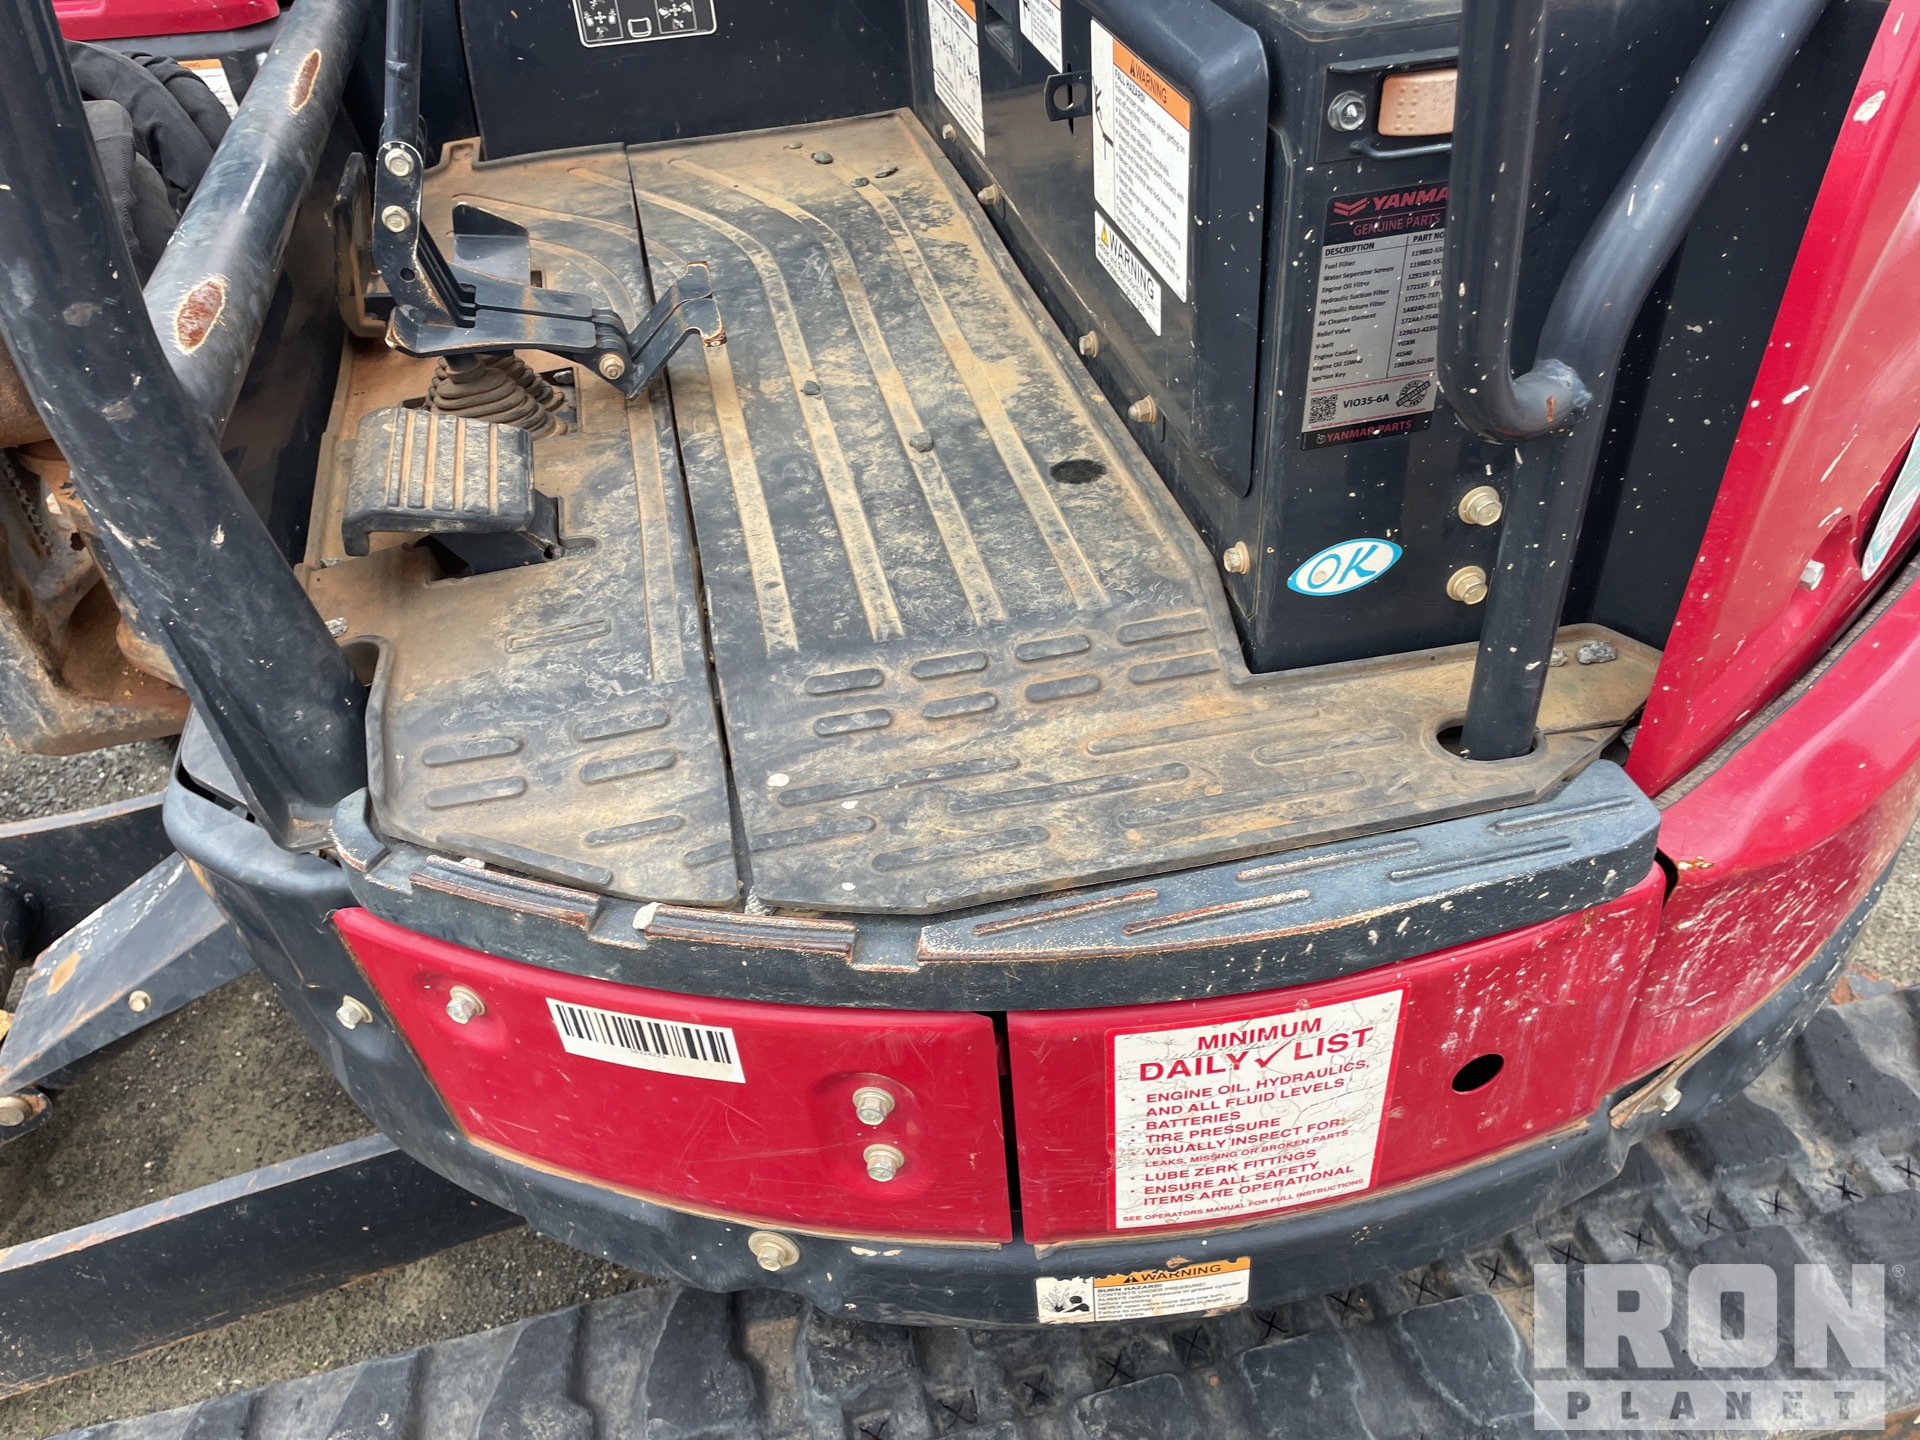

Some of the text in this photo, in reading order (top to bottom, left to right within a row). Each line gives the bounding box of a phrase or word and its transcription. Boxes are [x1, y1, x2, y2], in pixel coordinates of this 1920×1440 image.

[1135, 63, 1167, 104] WARNING
[1372, 186, 1448, 211] YANMA
[1353, 213, 1441, 236] GENUINE PARTS
[1412, 233, 1432, 243] PART
[1325, 242, 1375, 257] DESCRIPTION
[1411, 247, 1444, 257] 119802-55
[1109, 230, 1155, 300] WARNING
[1373, 266, 1394, 274] Screen
[1321, 289, 1390, 305] Hydraulic Suction Filter
[1322, 285, 1342, 293] Engine
[1319, 306, 1347, 316] Hydraulic
[1348, 303, 1368, 311] Return
[1327, 317, 1350, 325] Cleaner
[1351, 313, 1376, 321] Element
[1317, 330, 1334, 338] Relief
[1314, 349, 1358, 361] Engine Coolant
[1334, 371, 1346, 379] Key
[1327, 420, 1412, 442] YANMAR PARTS
[1307, 544, 1378, 589] OK
[1198, 1017, 1322, 1050] MINIMUM
[1140, 1027, 1374, 1081] DAILY LIST
[1146, 1059, 1370, 1103] ENGINE OIL, HYDRAULICS,
[1146, 1078, 1345, 1117] AND ALL FLUID LEVELS
[1145, 1117, 1281, 1143] TIRE PRESSURE
[1146, 1111, 1241, 1130] BATTERIES
[1145, 1139, 1226, 1156] VISUALLY
[1231, 1126, 1303, 1146] INSPECT
[1190, 1151, 1237, 1163] MISSING
[1241, 1147, 1258, 1156] OR
[1261, 1139, 1310, 1153] BROKEN
[1312, 1129, 1349, 1143] PARTS
[1145, 1149, 1317, 1182] LUBE ZERK FITTINGS
[1143, 1165, 1355, 1206] ITEMS ARE OPERATIONAL
[1144, 1161, 1320, 1195] ENSURE ALL SAFETY
[1144, 1208, 1204, 1220] OPERATORS
[1206, 1203, 1246, 1213] MANUAL
[1248, 1199, 1268, 1207] FOR
[1270, 1194, 1294, 1203] FULL
[1296, 1178, 1364, 1198] INSTRUCTIONS
[1141, 1264, 1221, 1281] WARNING
[1124, 1283, 1162, 1291] HAZARD!
[1152, 1290, 1181, 1298] pressure
